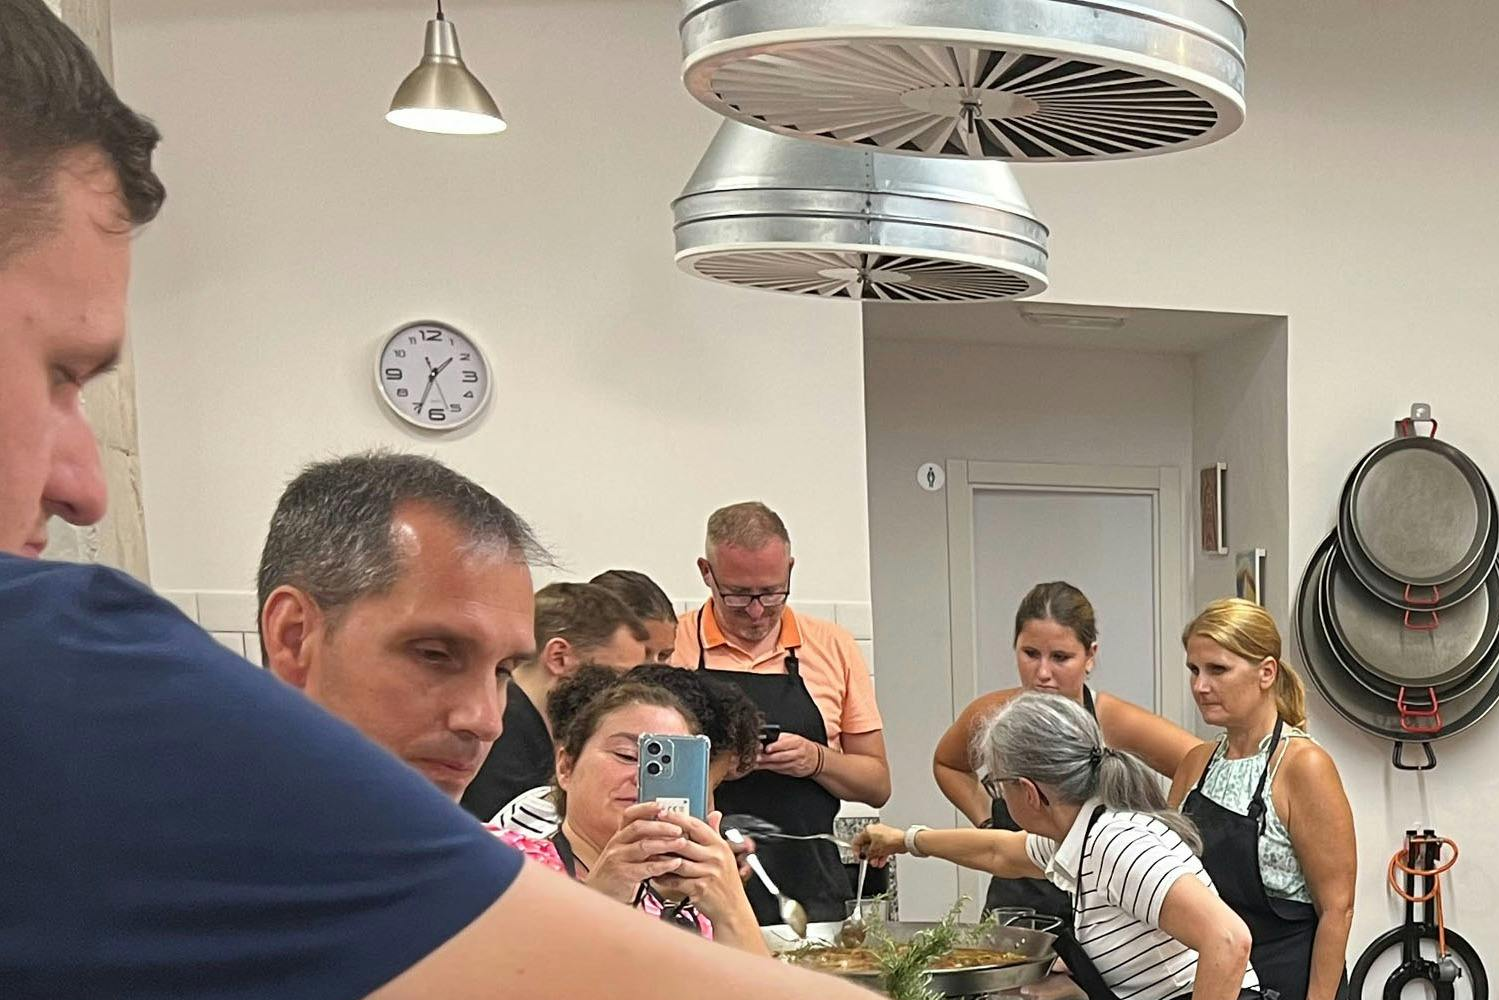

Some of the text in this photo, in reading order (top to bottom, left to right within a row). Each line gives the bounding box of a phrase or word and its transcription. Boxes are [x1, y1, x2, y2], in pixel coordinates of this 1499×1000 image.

[419, 330, 442, 341] 12
[394, 350, 406, 358] 10
[460, 353, 470, 361] 2
[385, 368, 403, 380] 9
[462, 371, 478, 383] 3
[397, 388, 408, 397] 8
[450, 404, 462, 412] 5
[428, 408, 446, 421] 6
